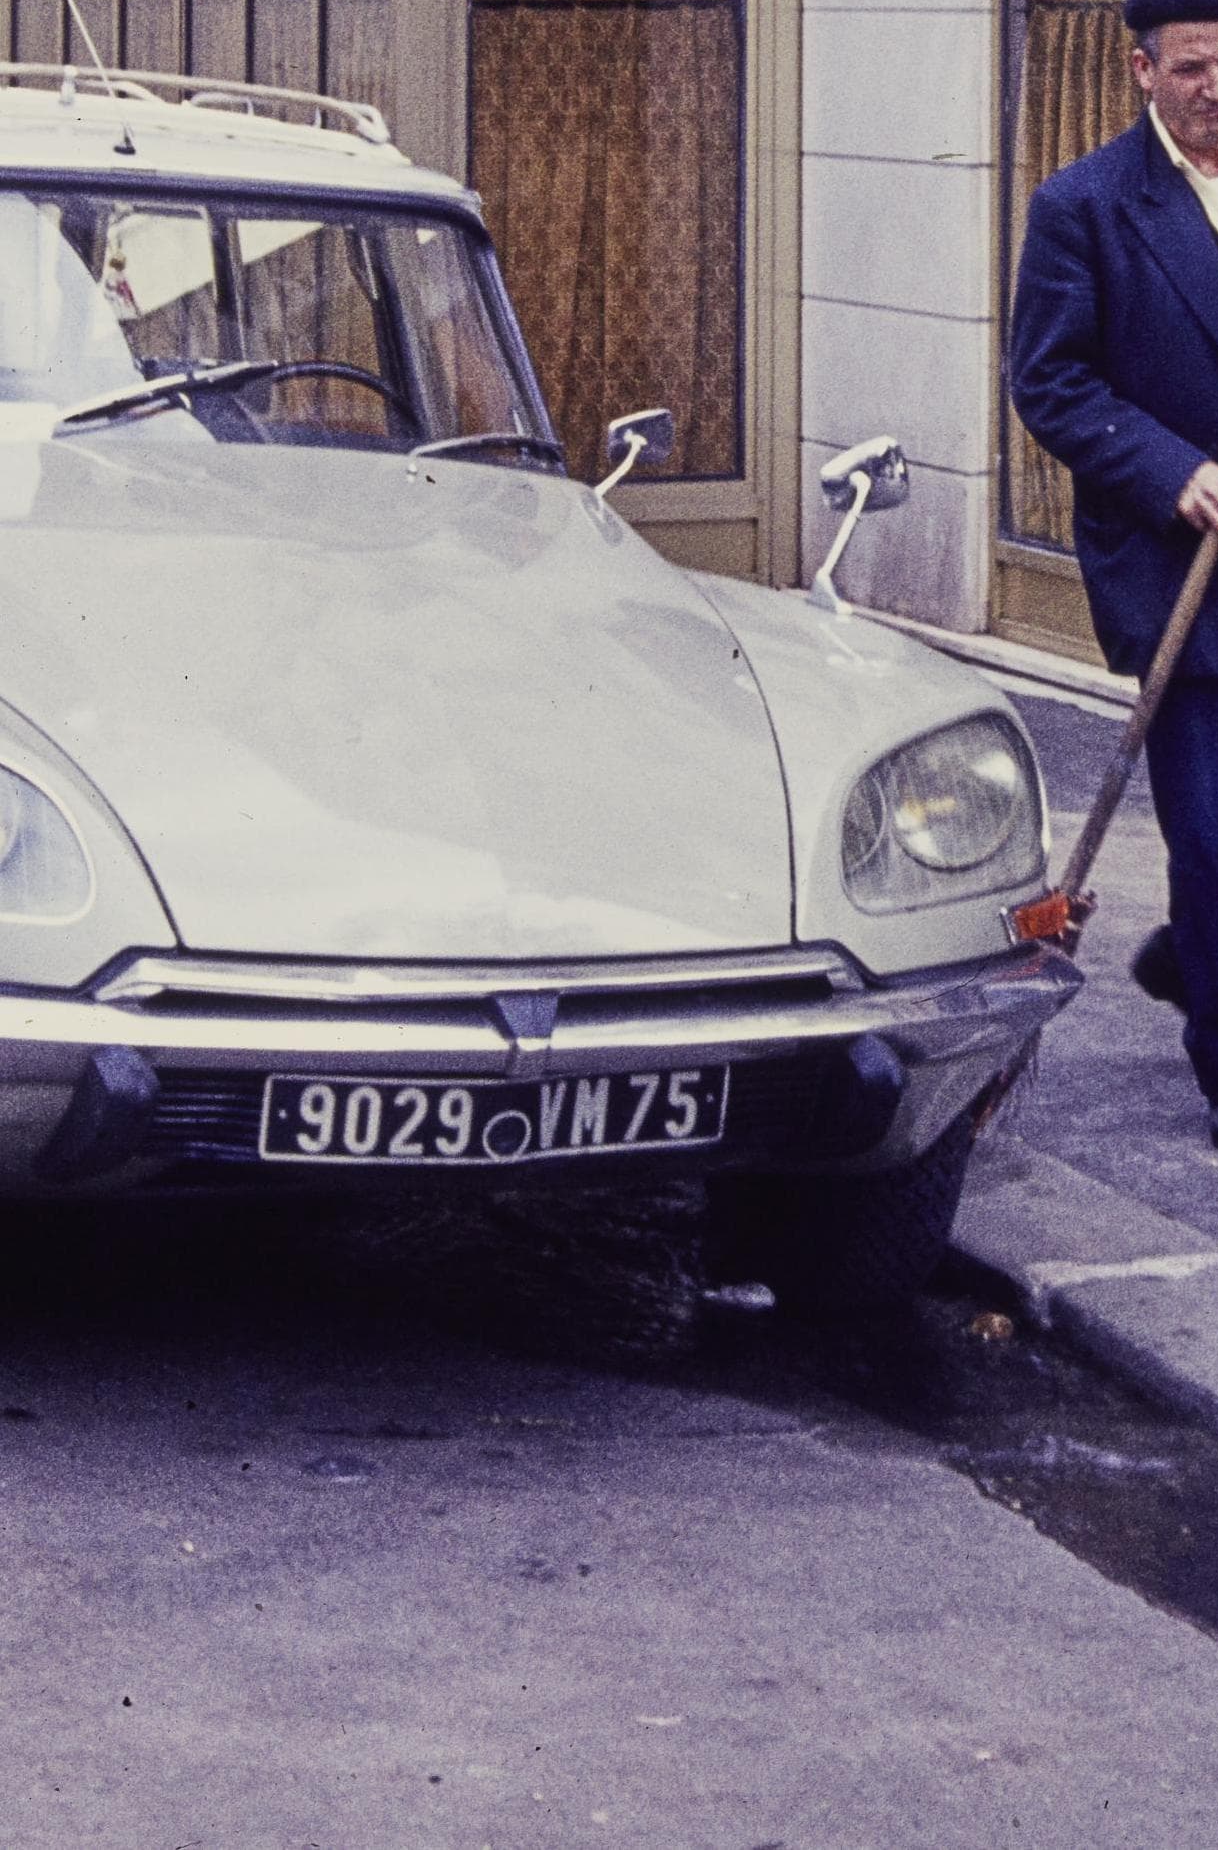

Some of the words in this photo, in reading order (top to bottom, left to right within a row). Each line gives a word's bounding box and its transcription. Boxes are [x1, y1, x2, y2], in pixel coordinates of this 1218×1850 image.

[296, 1084, 474, 1157] 9029
[538, 1077, 610, 1150] VM
[623, 1069, 701, 1142] 75
